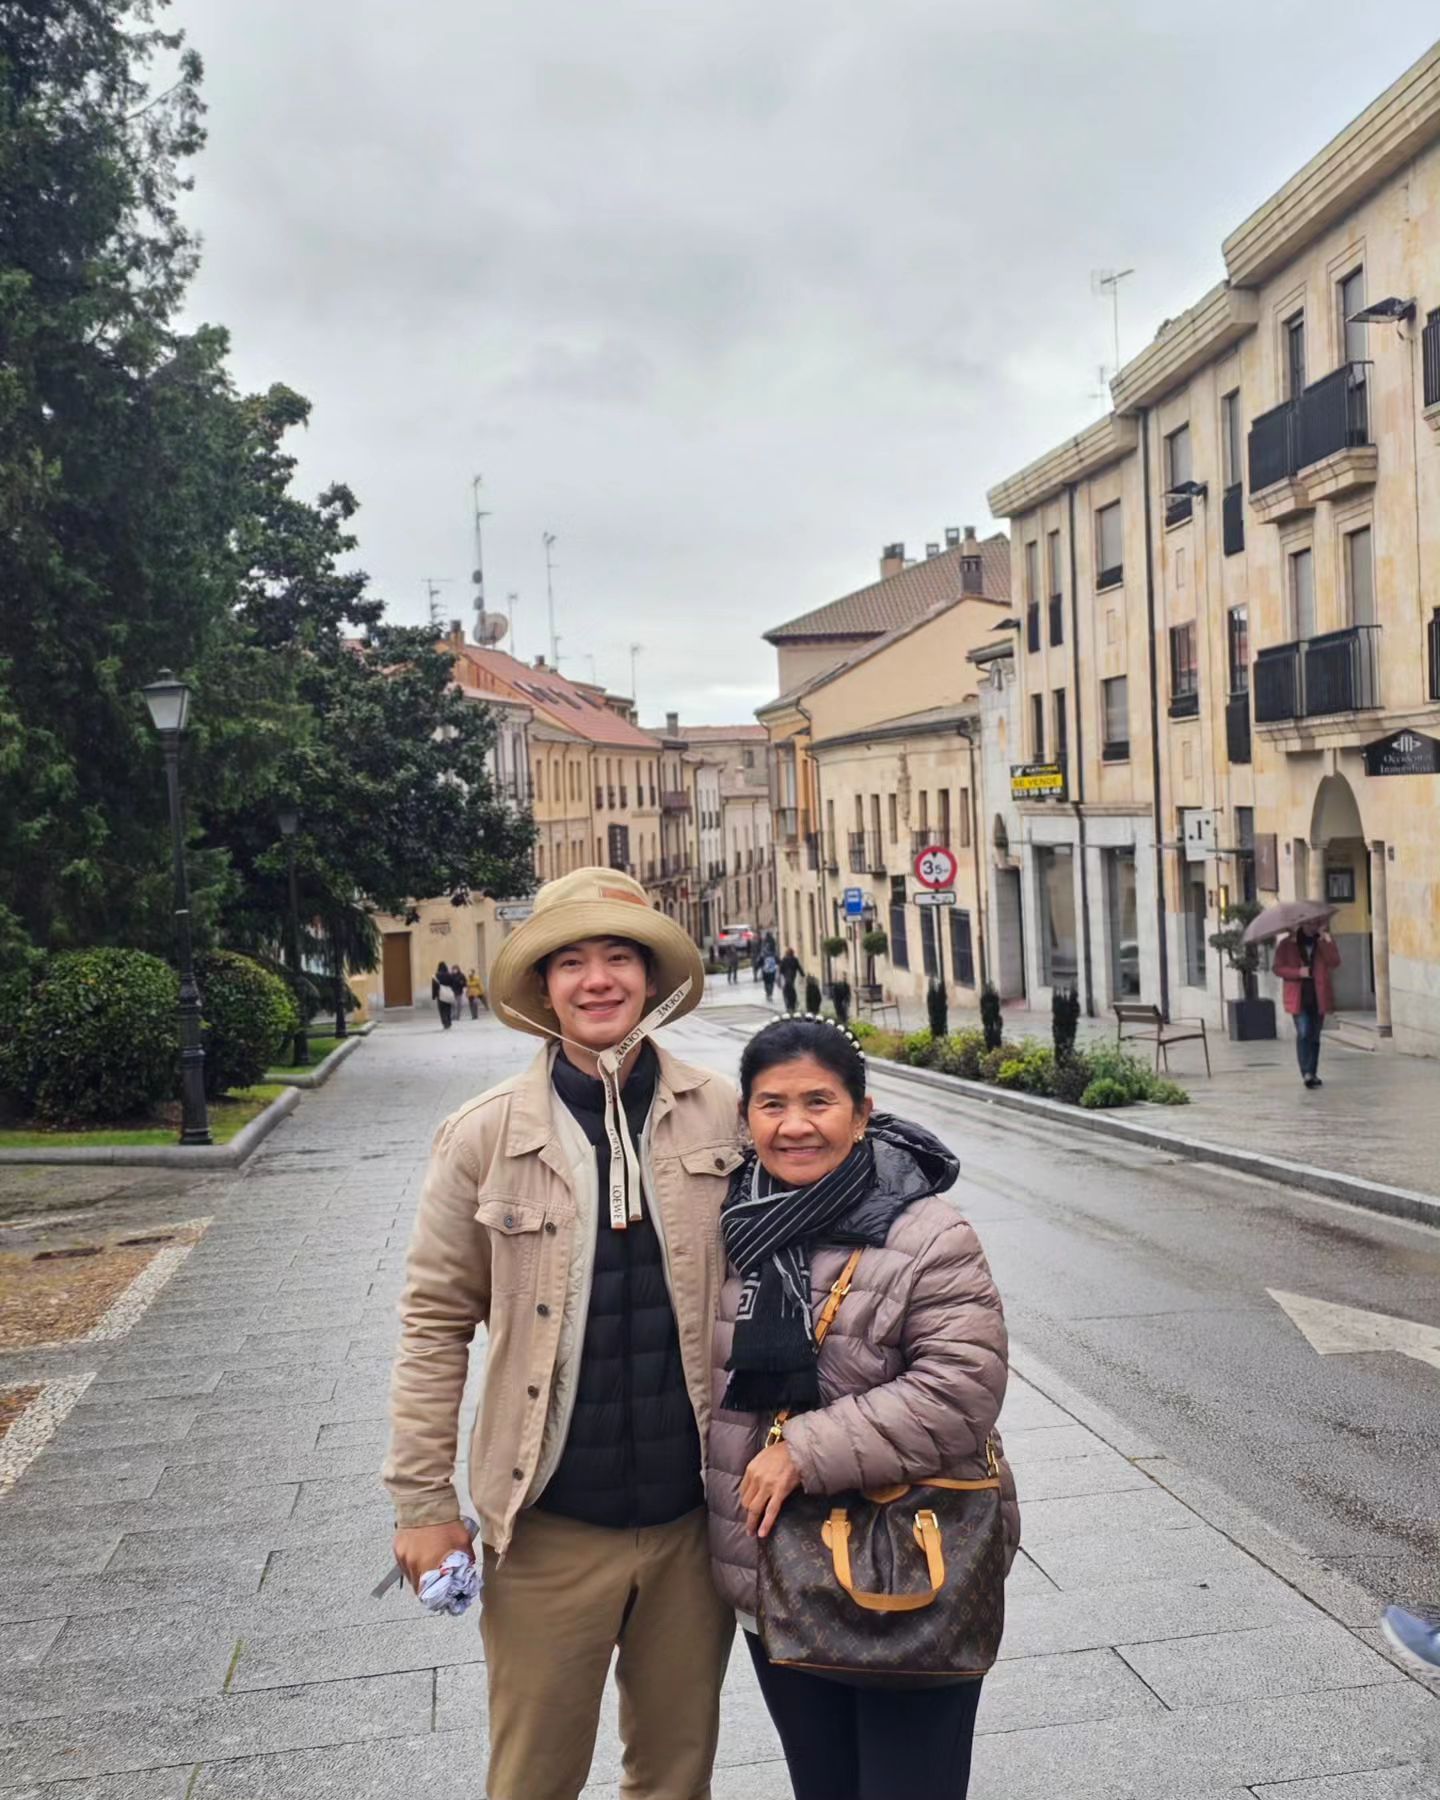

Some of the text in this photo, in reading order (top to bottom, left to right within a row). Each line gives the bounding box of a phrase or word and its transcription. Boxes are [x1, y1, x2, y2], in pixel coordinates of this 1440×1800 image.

[1027, 776, 1058, 786] VENDE
[656, 990, 685, 1018] LOEWE
[616, 1027, 644, 1056] LOEWE
[612, 1184, 623, 1218] LOEWE
